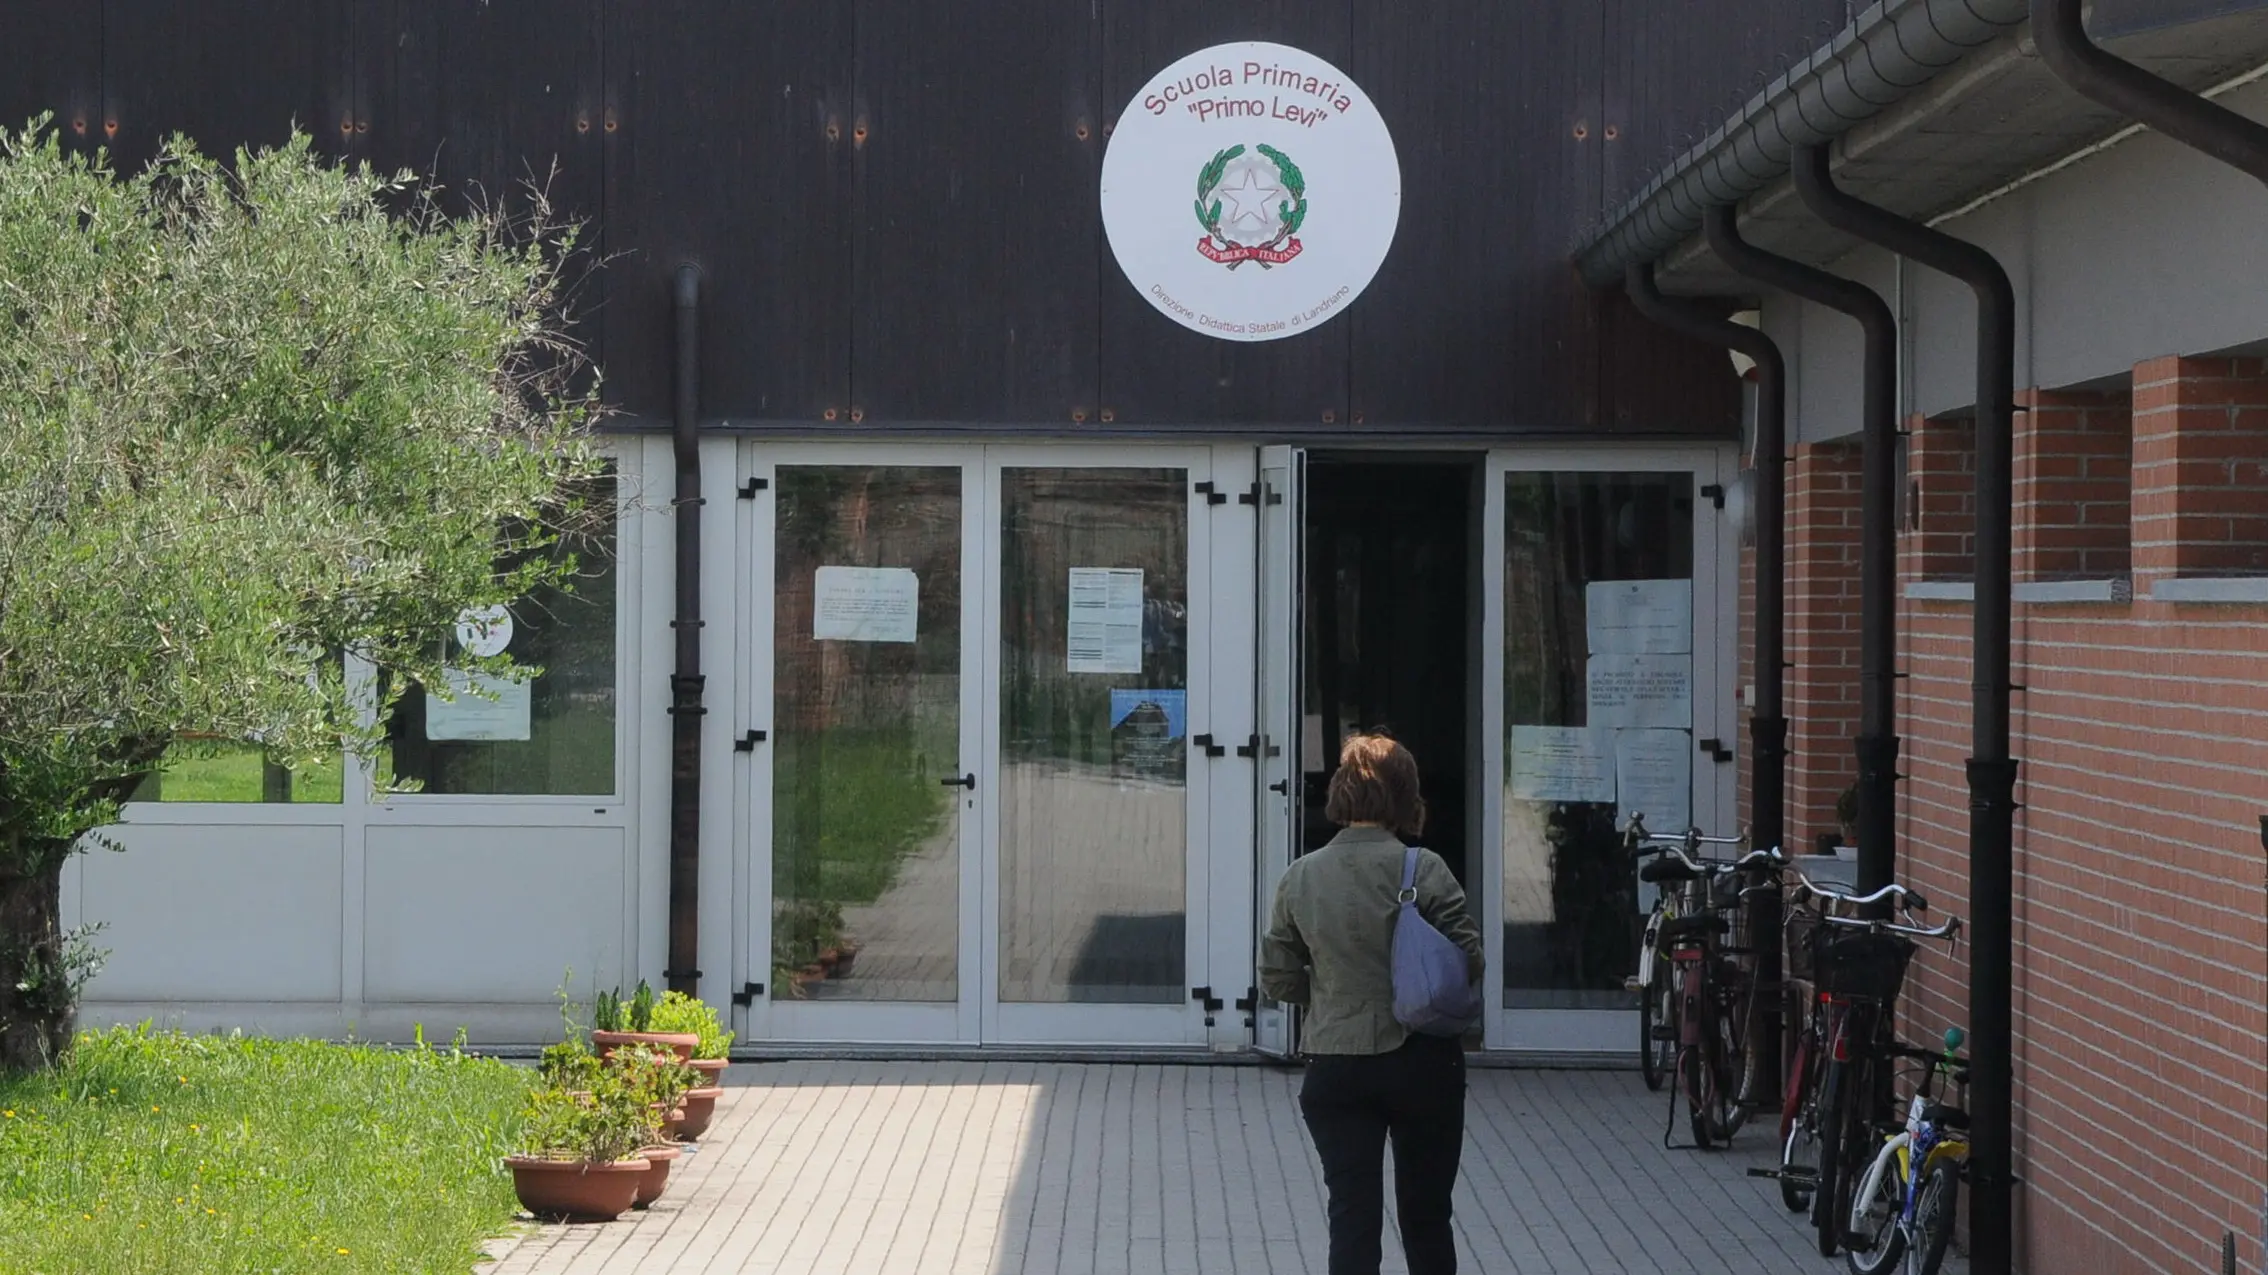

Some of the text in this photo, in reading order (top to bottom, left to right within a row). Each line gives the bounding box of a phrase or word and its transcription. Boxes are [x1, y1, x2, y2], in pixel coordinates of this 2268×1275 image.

[1144, 62, 1352, 116] Scuola Primaria
[1187, 96, 1328, 128] "Primo Levi"
[1258, 242, 1300, 260] ITALIANA
[1151, 284, 1350, 334] Direzione Didattica Statale di Landriano
